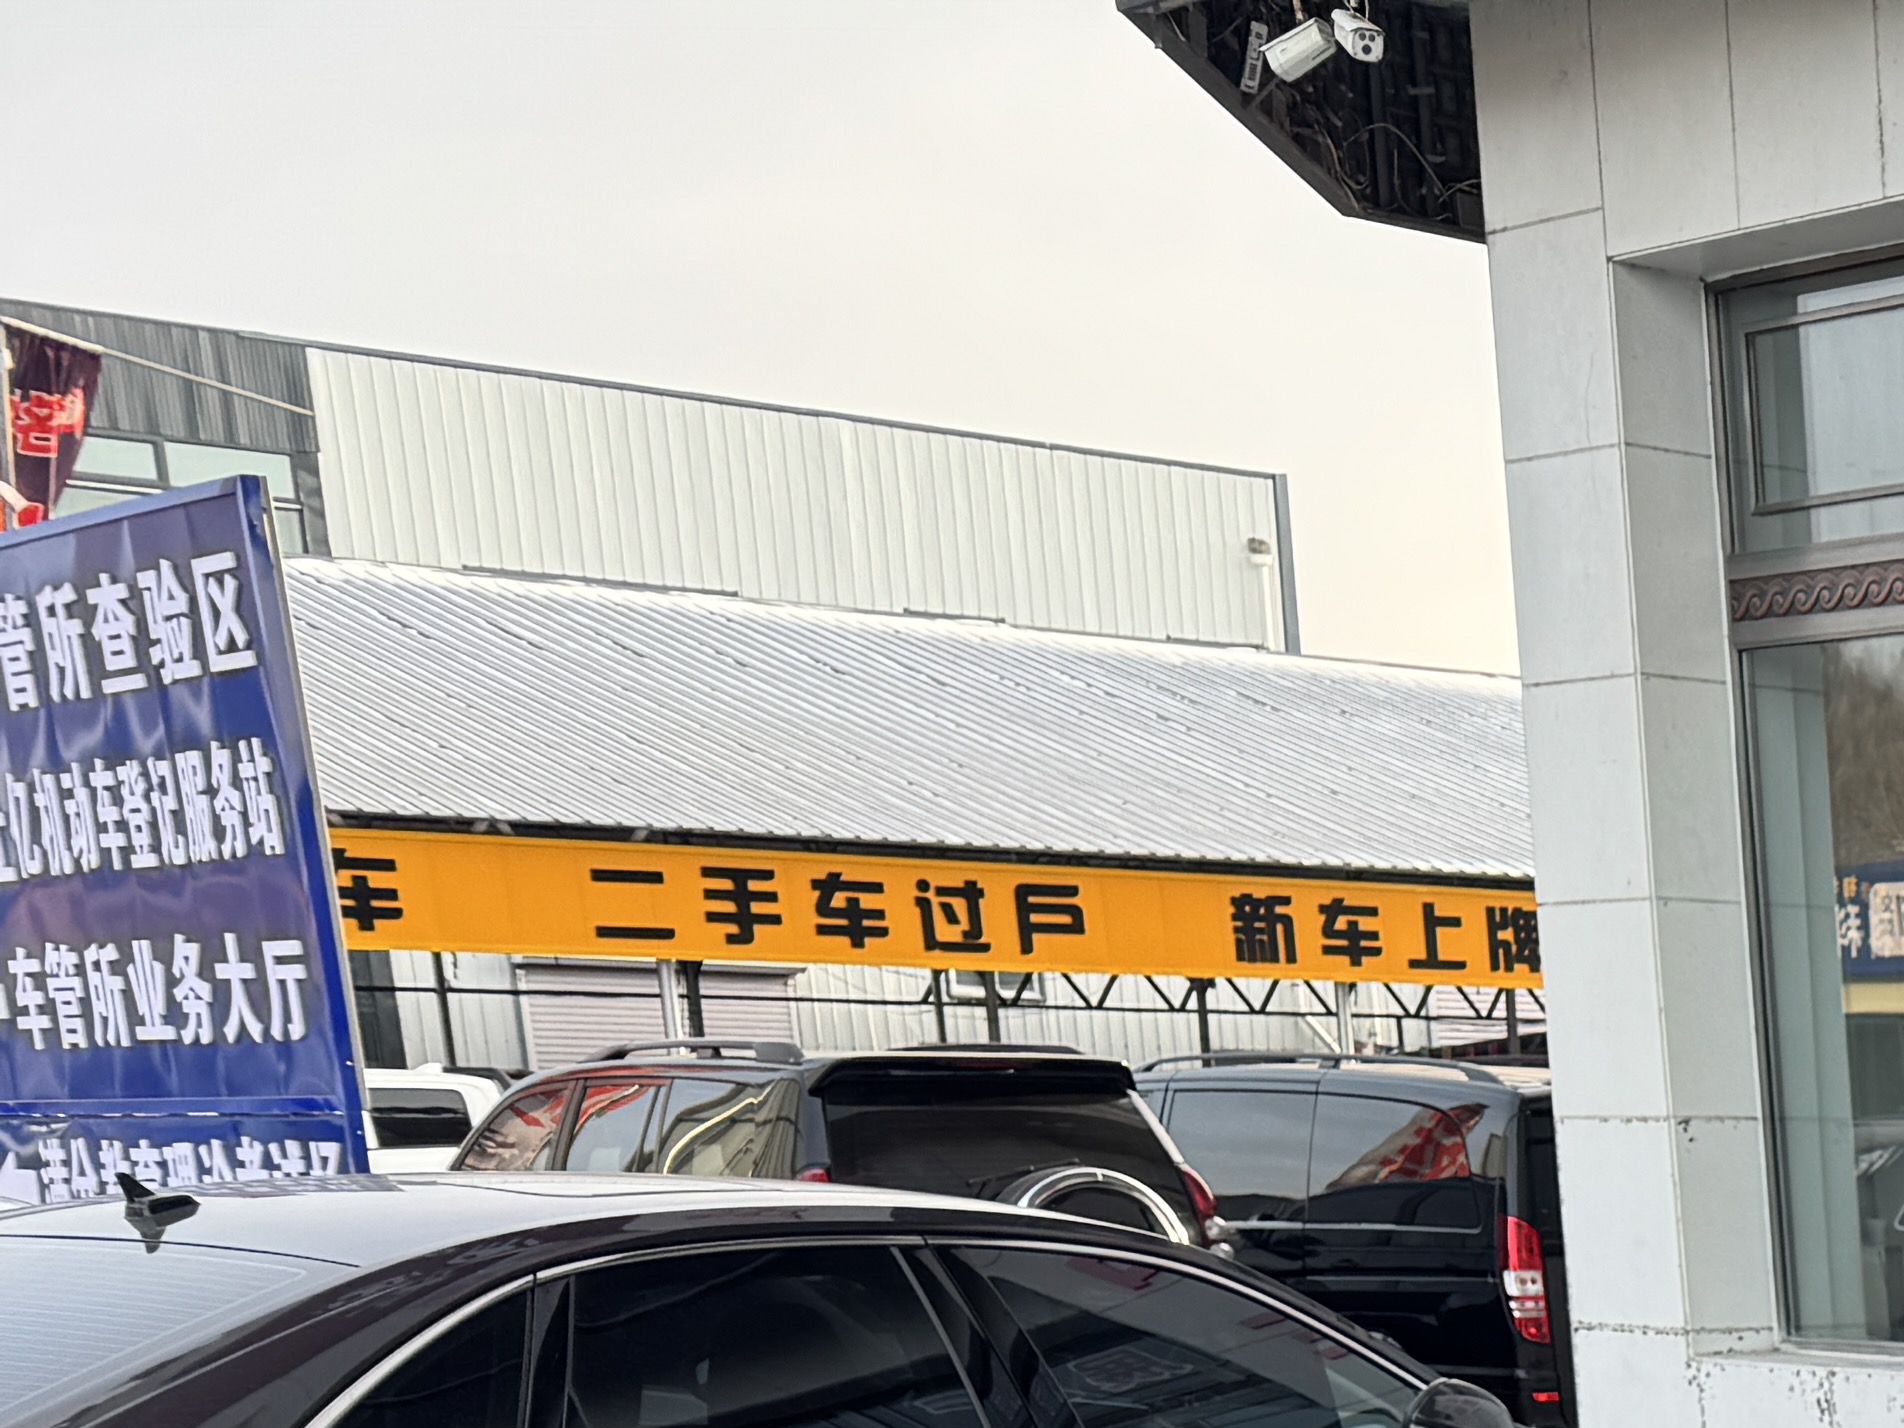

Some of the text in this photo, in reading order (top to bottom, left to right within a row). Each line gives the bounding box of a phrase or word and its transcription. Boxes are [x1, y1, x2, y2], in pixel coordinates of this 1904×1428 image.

[589, 867, 1086, 955] 二手车过户
[1230, 893, 1541, 973] 新车上牌
[0, 932, 308, 1050] 车管所业务大厅
